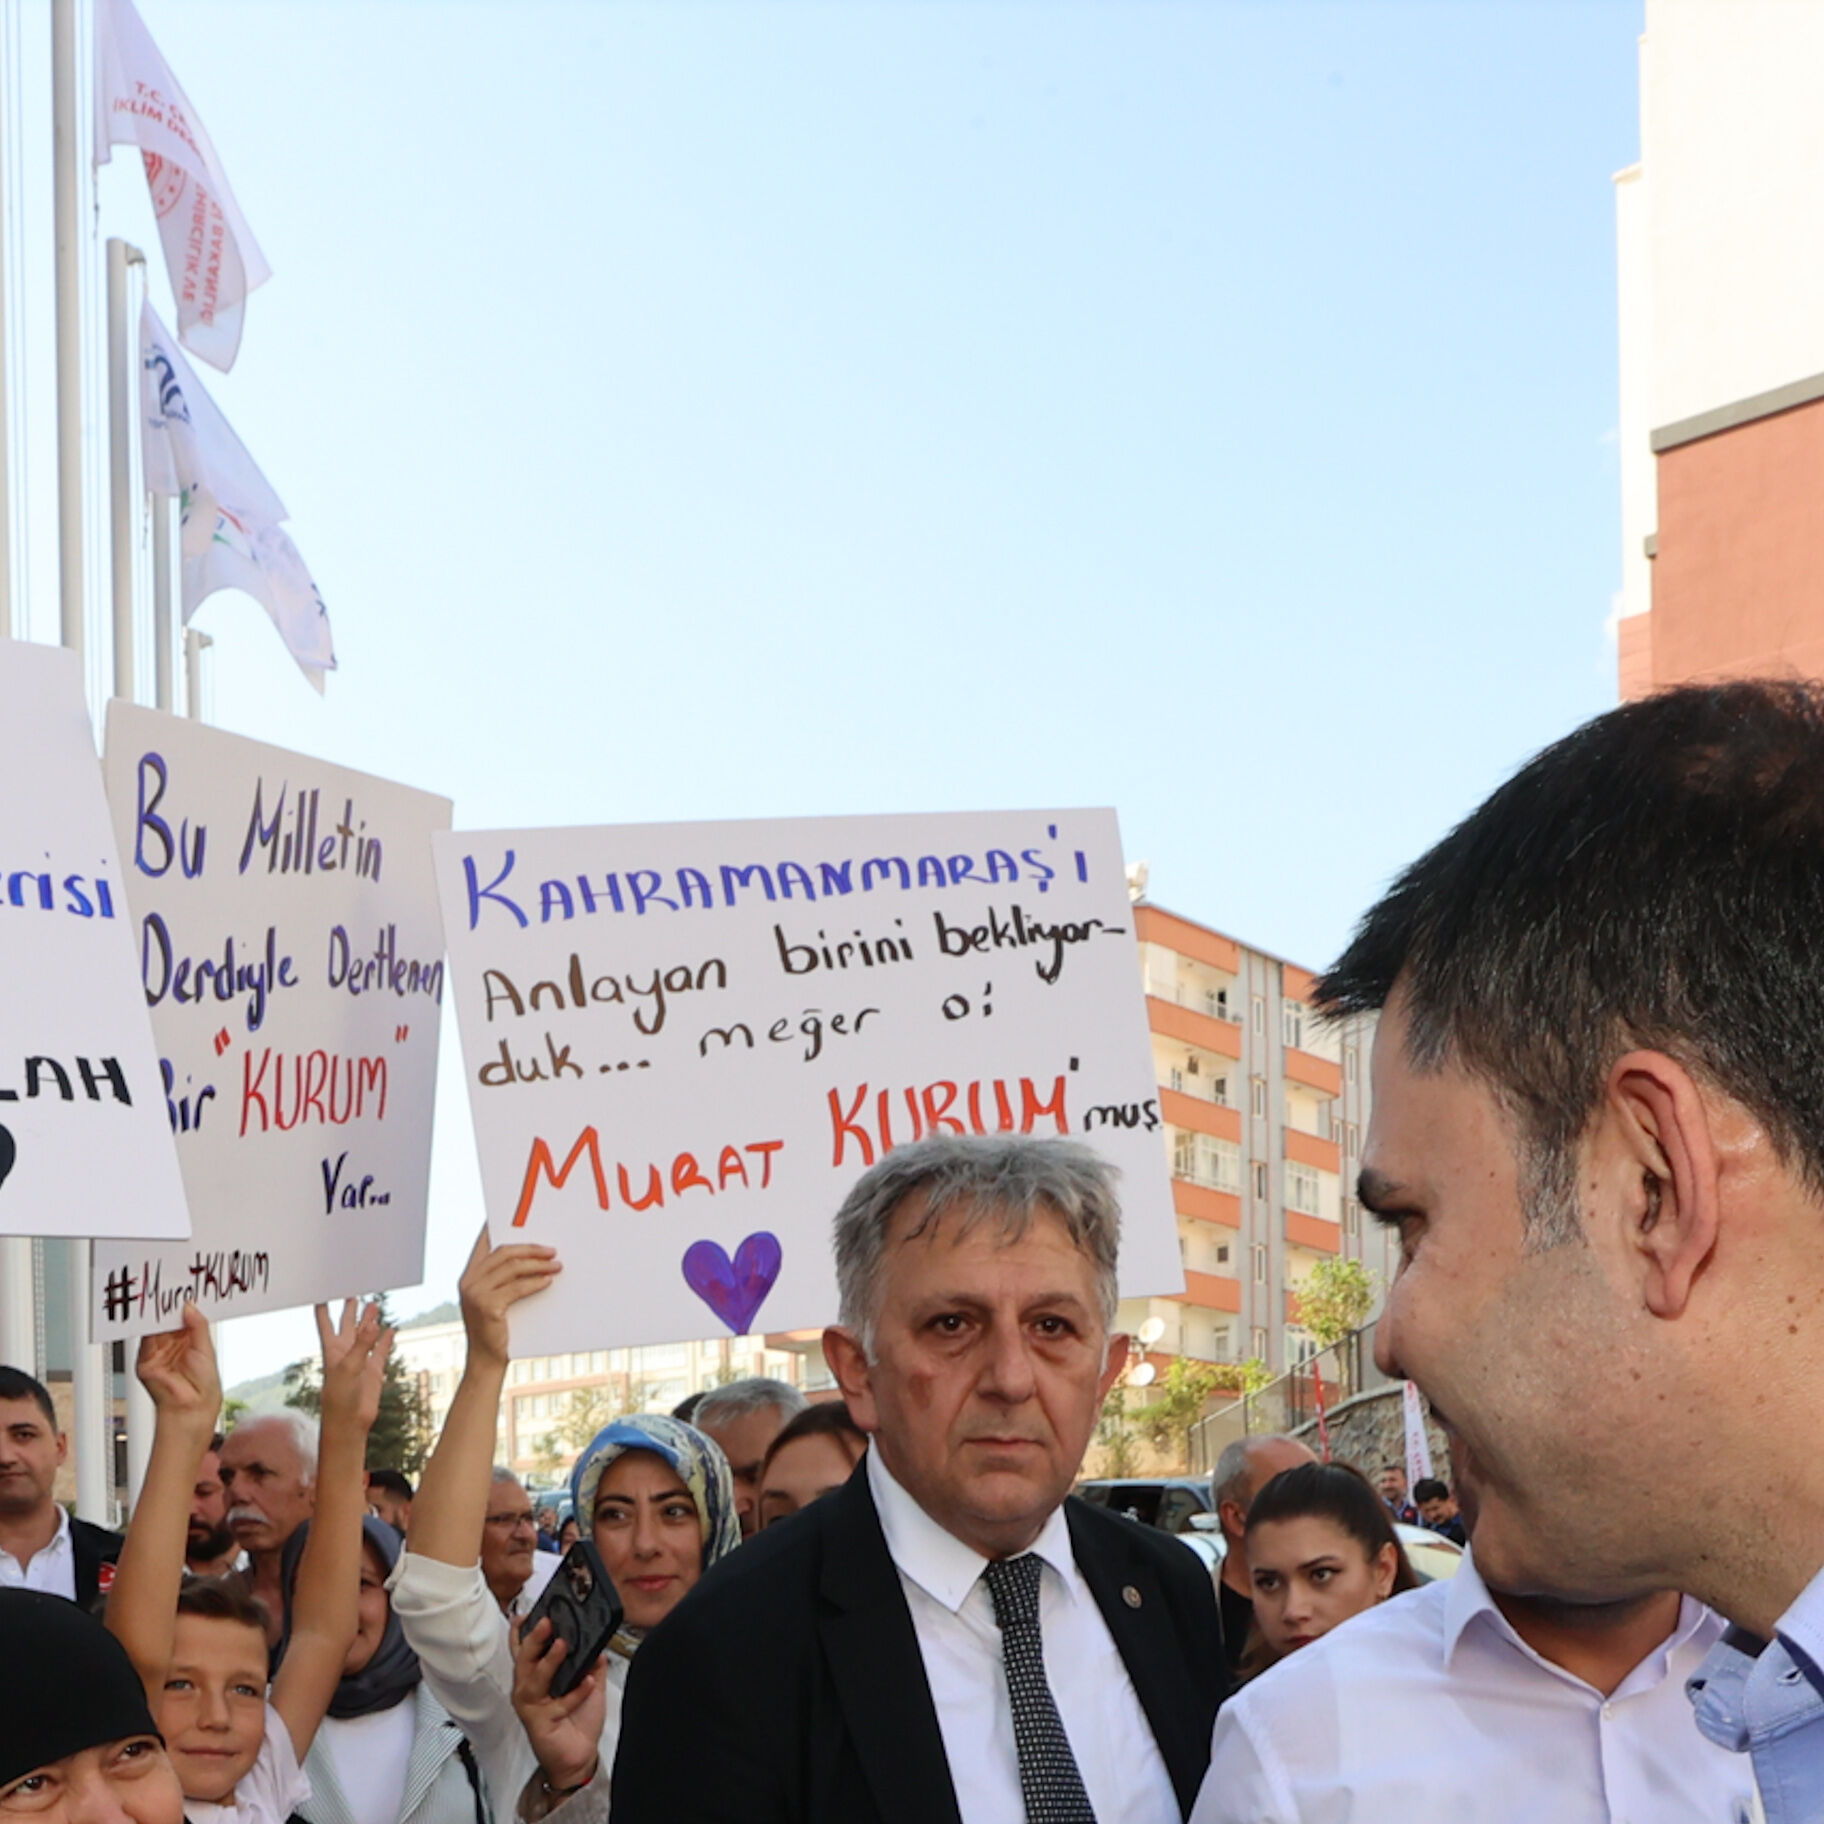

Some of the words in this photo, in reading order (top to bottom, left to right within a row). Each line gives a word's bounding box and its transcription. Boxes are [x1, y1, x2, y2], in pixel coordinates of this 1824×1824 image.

[135, 752, 206, 878] Bu
[239, 775, 382, 883] Milletin
[483, 954, 727, 1035] Anlayan
[774, 916, 914, 975] birini
[699, 1008, 880, 1062] meğer
